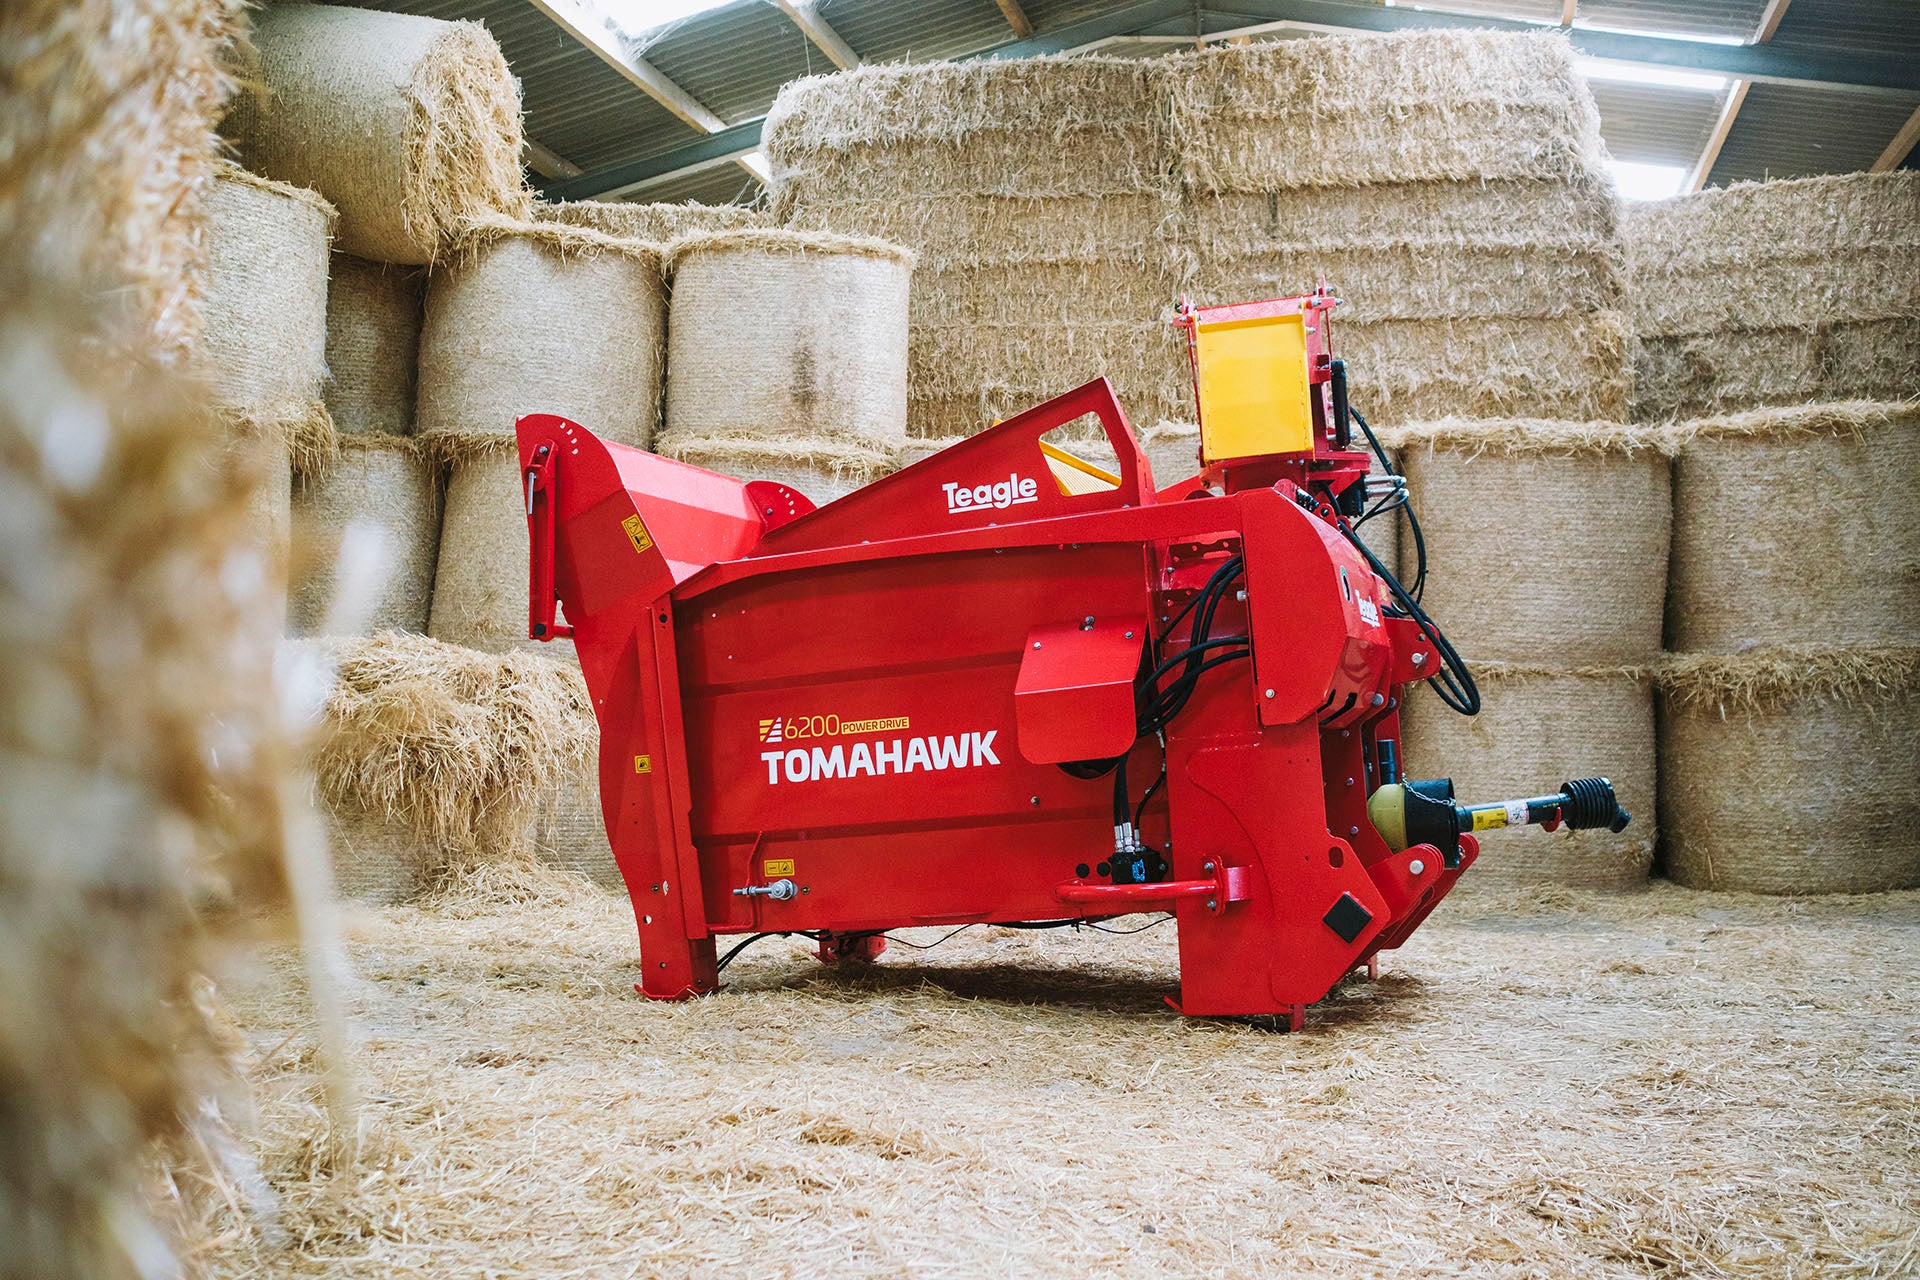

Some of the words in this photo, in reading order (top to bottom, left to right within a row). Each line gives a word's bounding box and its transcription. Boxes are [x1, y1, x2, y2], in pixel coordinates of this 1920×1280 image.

[942, 473, 1038, 510] Teagle
[784, 713, 840, 740] 6200
[842, 721, 878, 733] POWER
[879, 718, 908, 730] DRIVE
[761, 730, 1001, 785] TOMAHAWK
